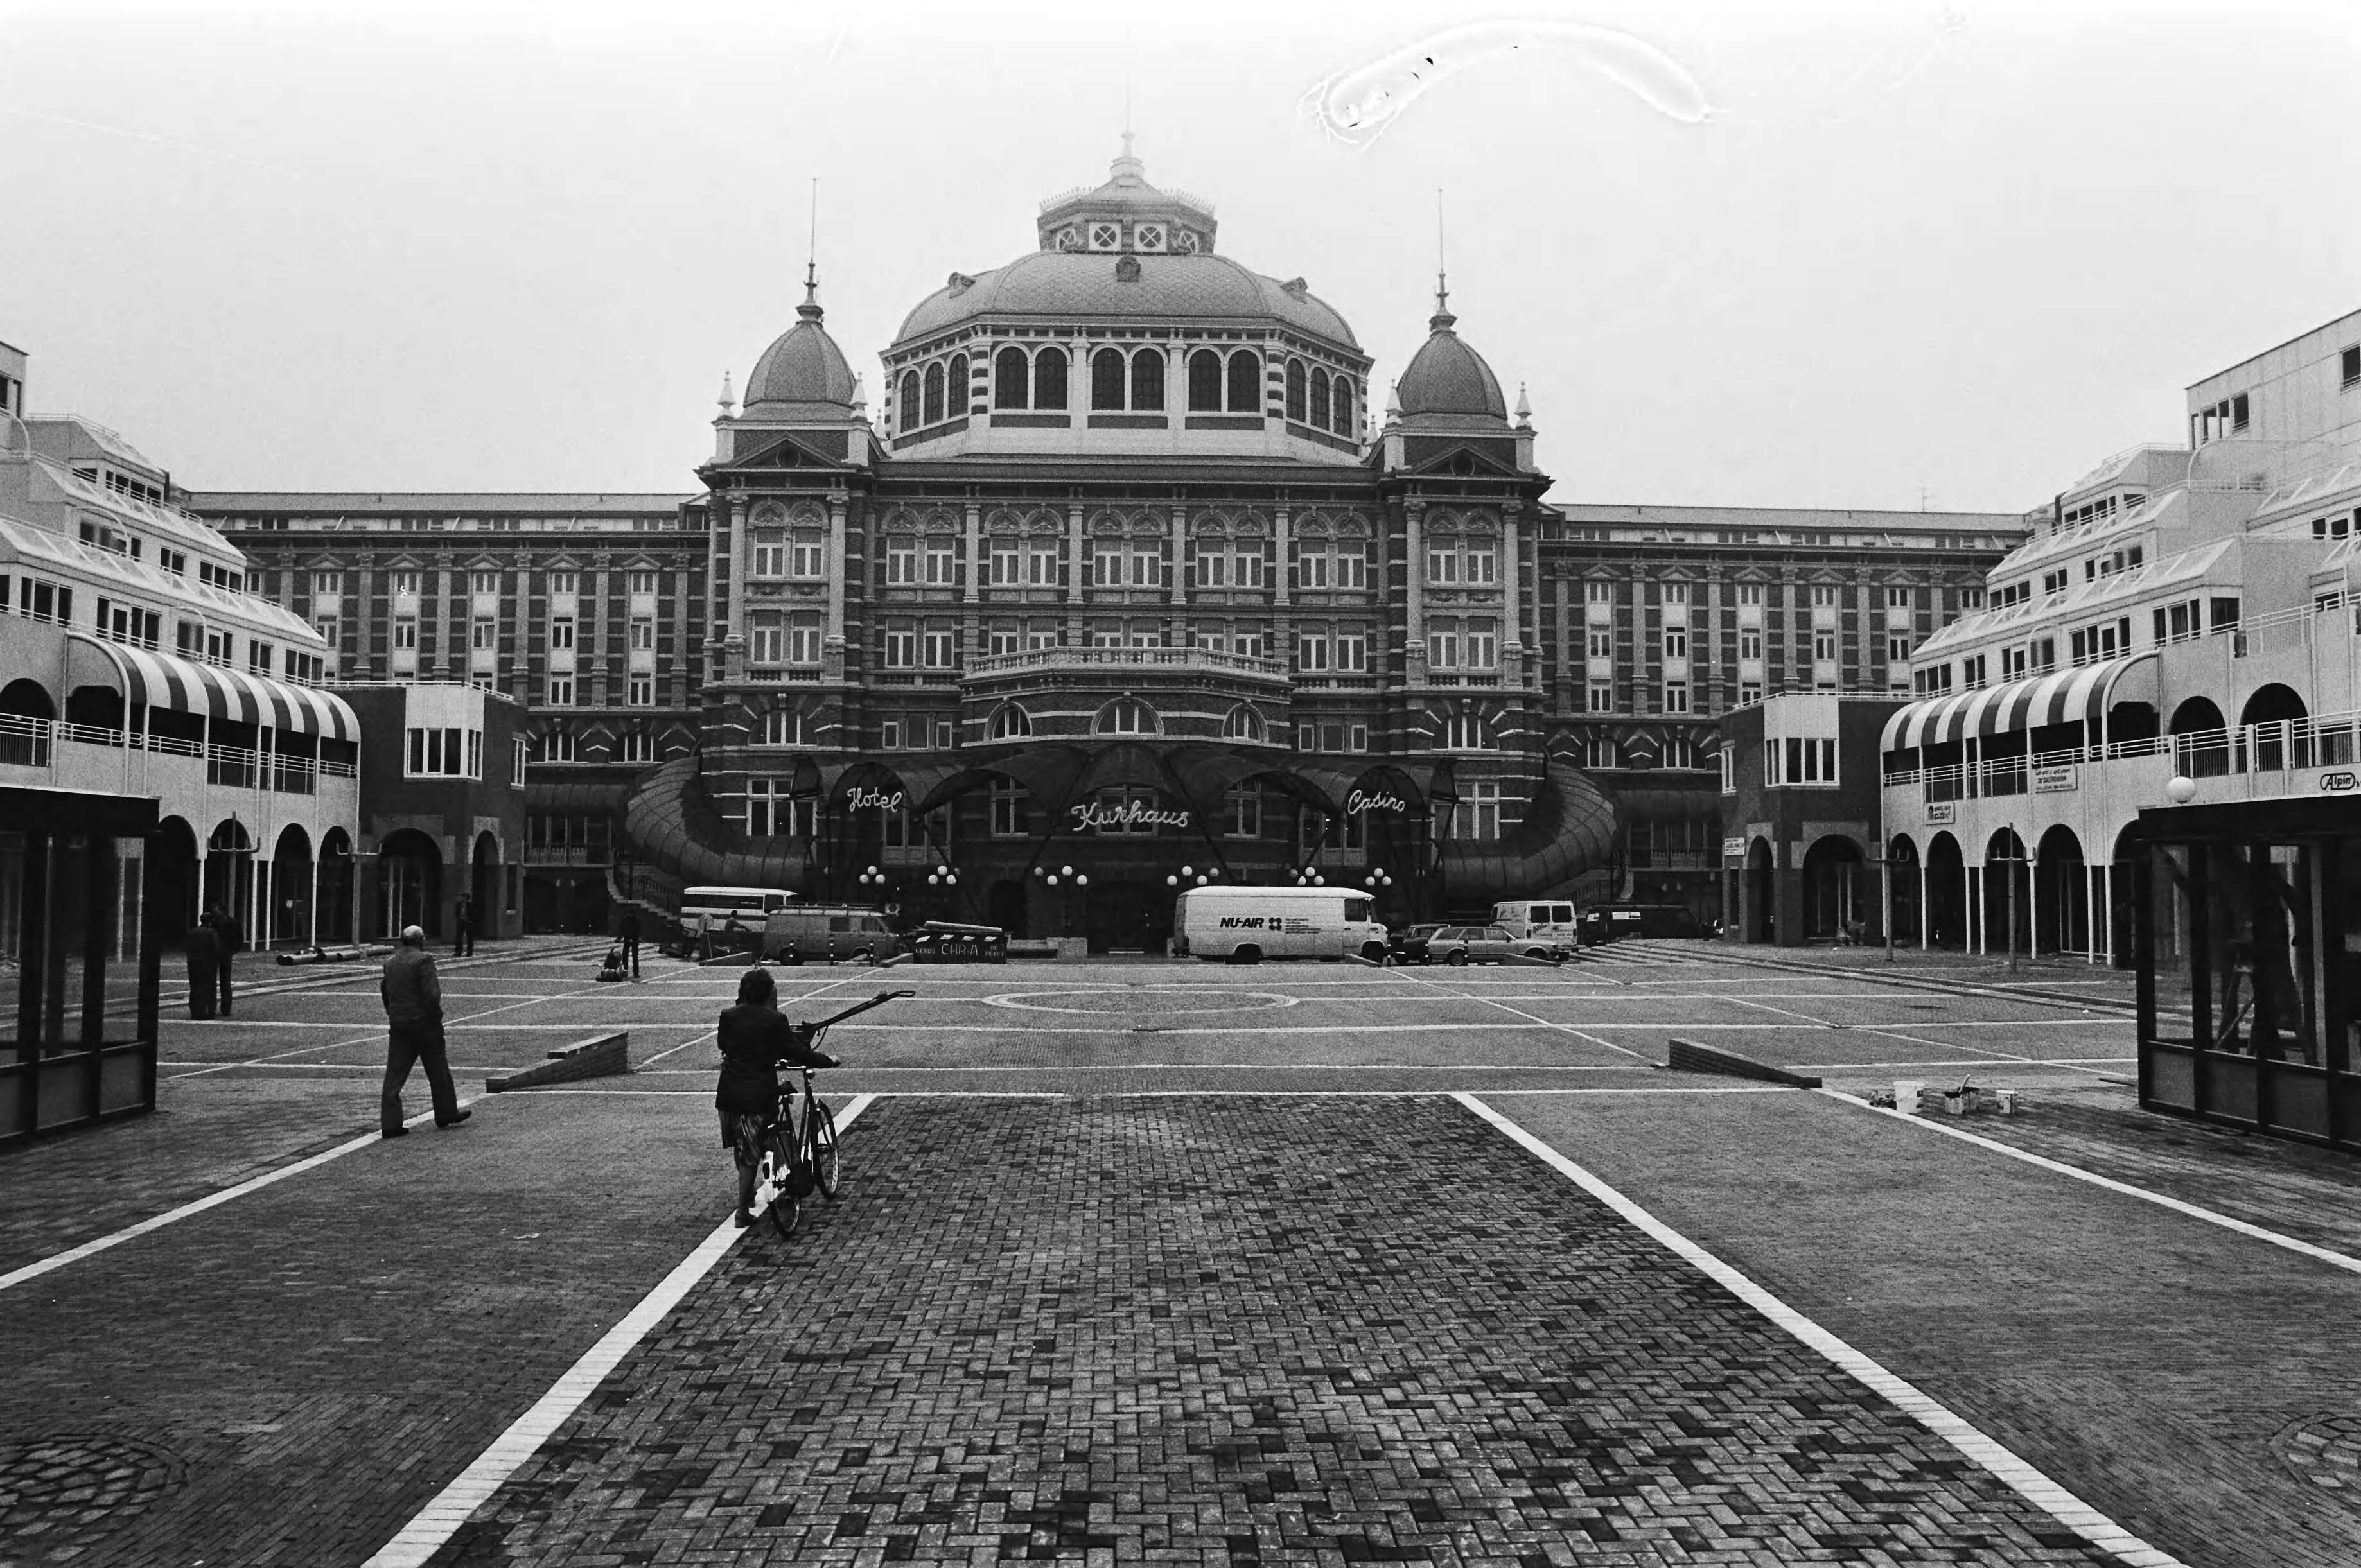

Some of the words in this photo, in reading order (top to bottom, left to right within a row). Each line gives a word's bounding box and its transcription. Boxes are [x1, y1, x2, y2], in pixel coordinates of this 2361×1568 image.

[847, 787, 902, 813] Hotel
[1347, 789, 1405, 814] Casino
[1071, 799, 1189, 832] Kurhaus
[1220, 917, 1264, 928] NU-AIR
